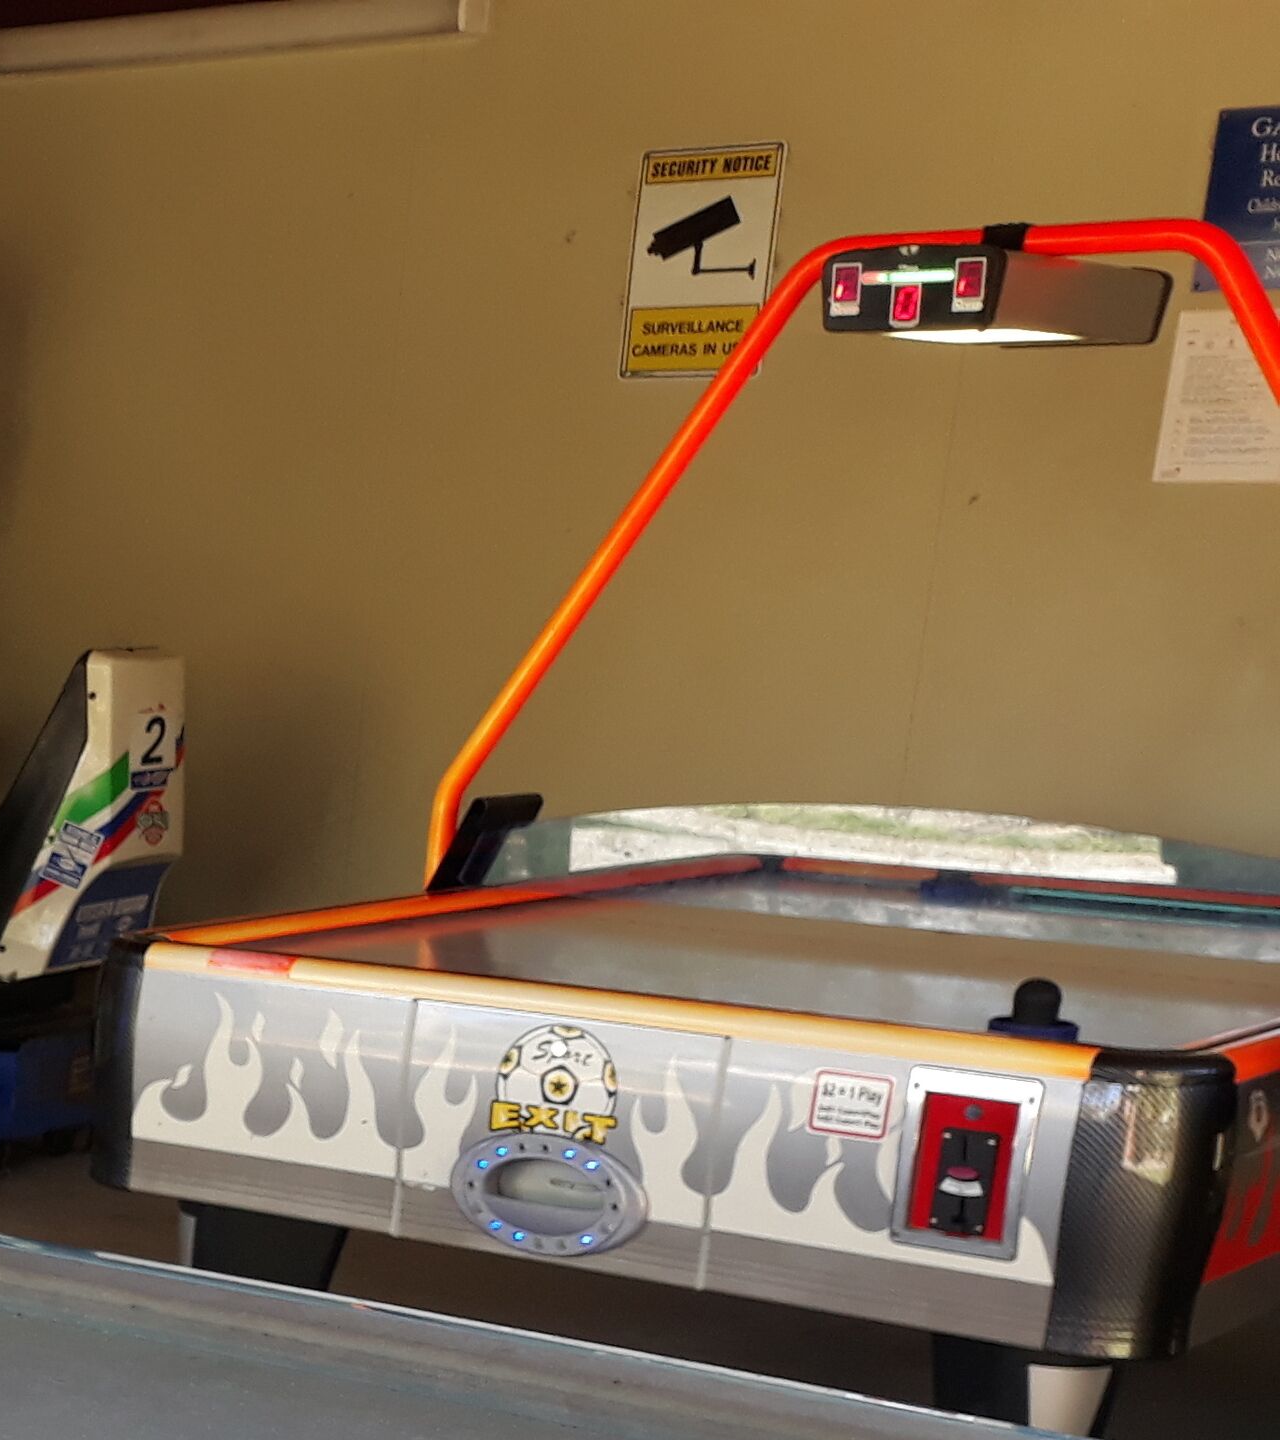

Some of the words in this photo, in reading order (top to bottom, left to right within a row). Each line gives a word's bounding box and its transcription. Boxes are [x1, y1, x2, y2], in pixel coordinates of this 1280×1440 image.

[651, 159, 717, 178] SECURITY
[722, 154, 772, 172] NOTICE
[642, 320, 743, 335] SURVEILLANCE
[632, 345, 697, 356] CAMERAS
[703, 343, 718, 355] IN
[141, 716, 166, 765] 2
[490, 1100, 617, 1145] EXIT
